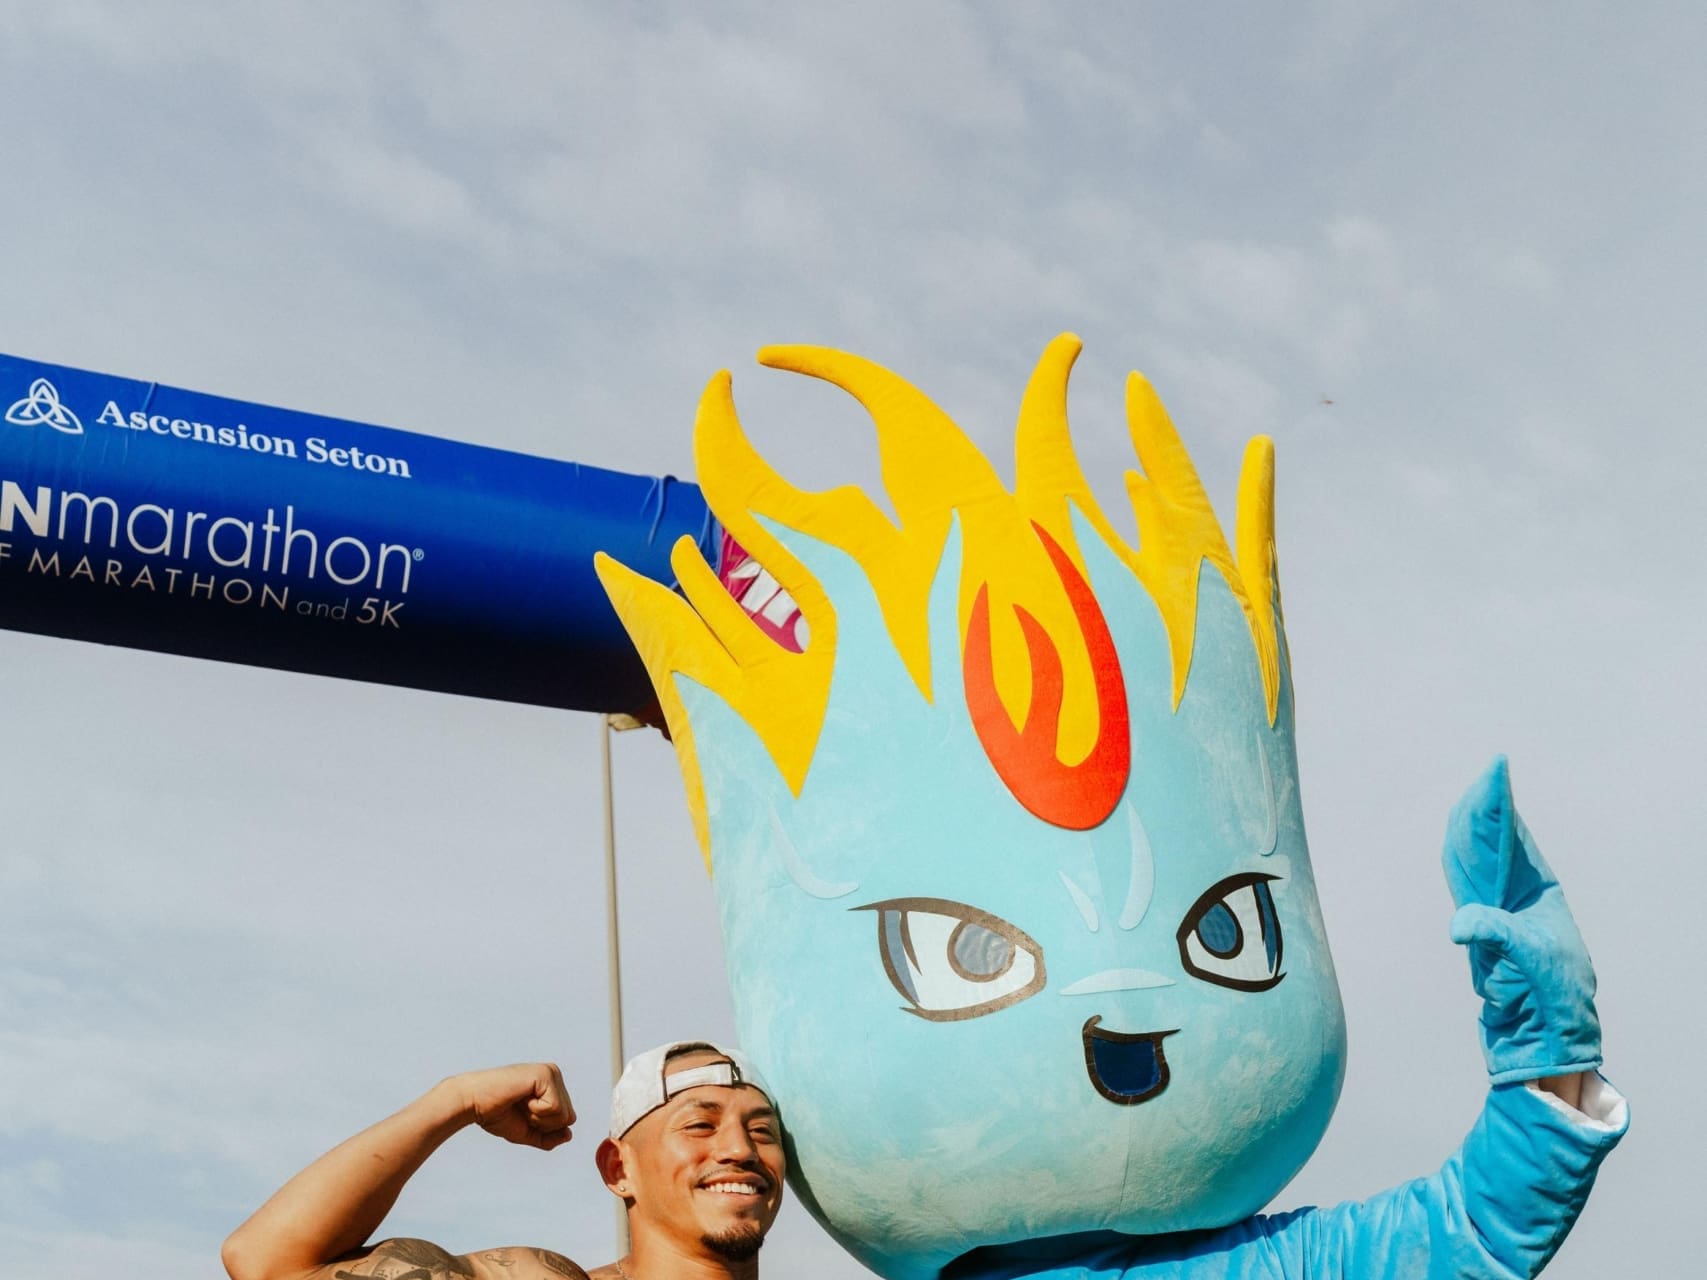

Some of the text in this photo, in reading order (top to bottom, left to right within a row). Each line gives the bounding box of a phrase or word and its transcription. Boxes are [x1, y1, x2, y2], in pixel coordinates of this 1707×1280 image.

[96, 400, 412, 478] Ascension Seton
[27, 547, 290, 611] MARATHON
[296, 598, 350, 621] and
[356, 597, 406, 629] 5K
